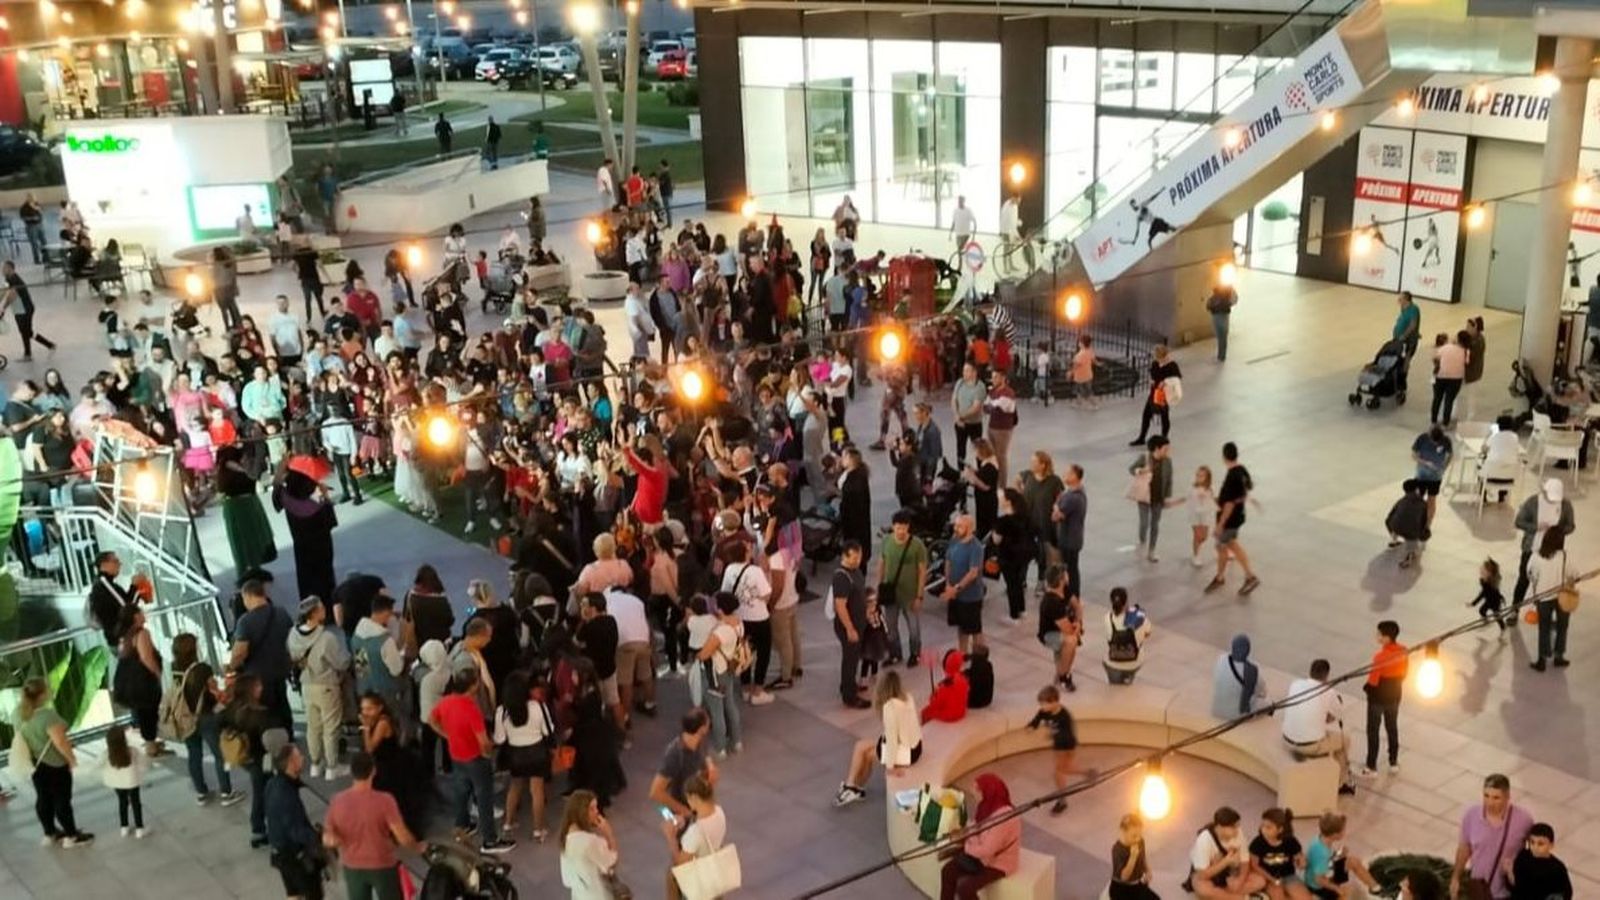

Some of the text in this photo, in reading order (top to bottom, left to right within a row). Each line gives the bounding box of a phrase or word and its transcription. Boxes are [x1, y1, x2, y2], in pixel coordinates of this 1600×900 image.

[1304, 52, 1334, 82] MONTE
[1309, 62, 1338, 91] CARLO
[1315, 76, 1345, 104] SPORTS
[1169, 154, 1220, 206] PRÓXIMA
